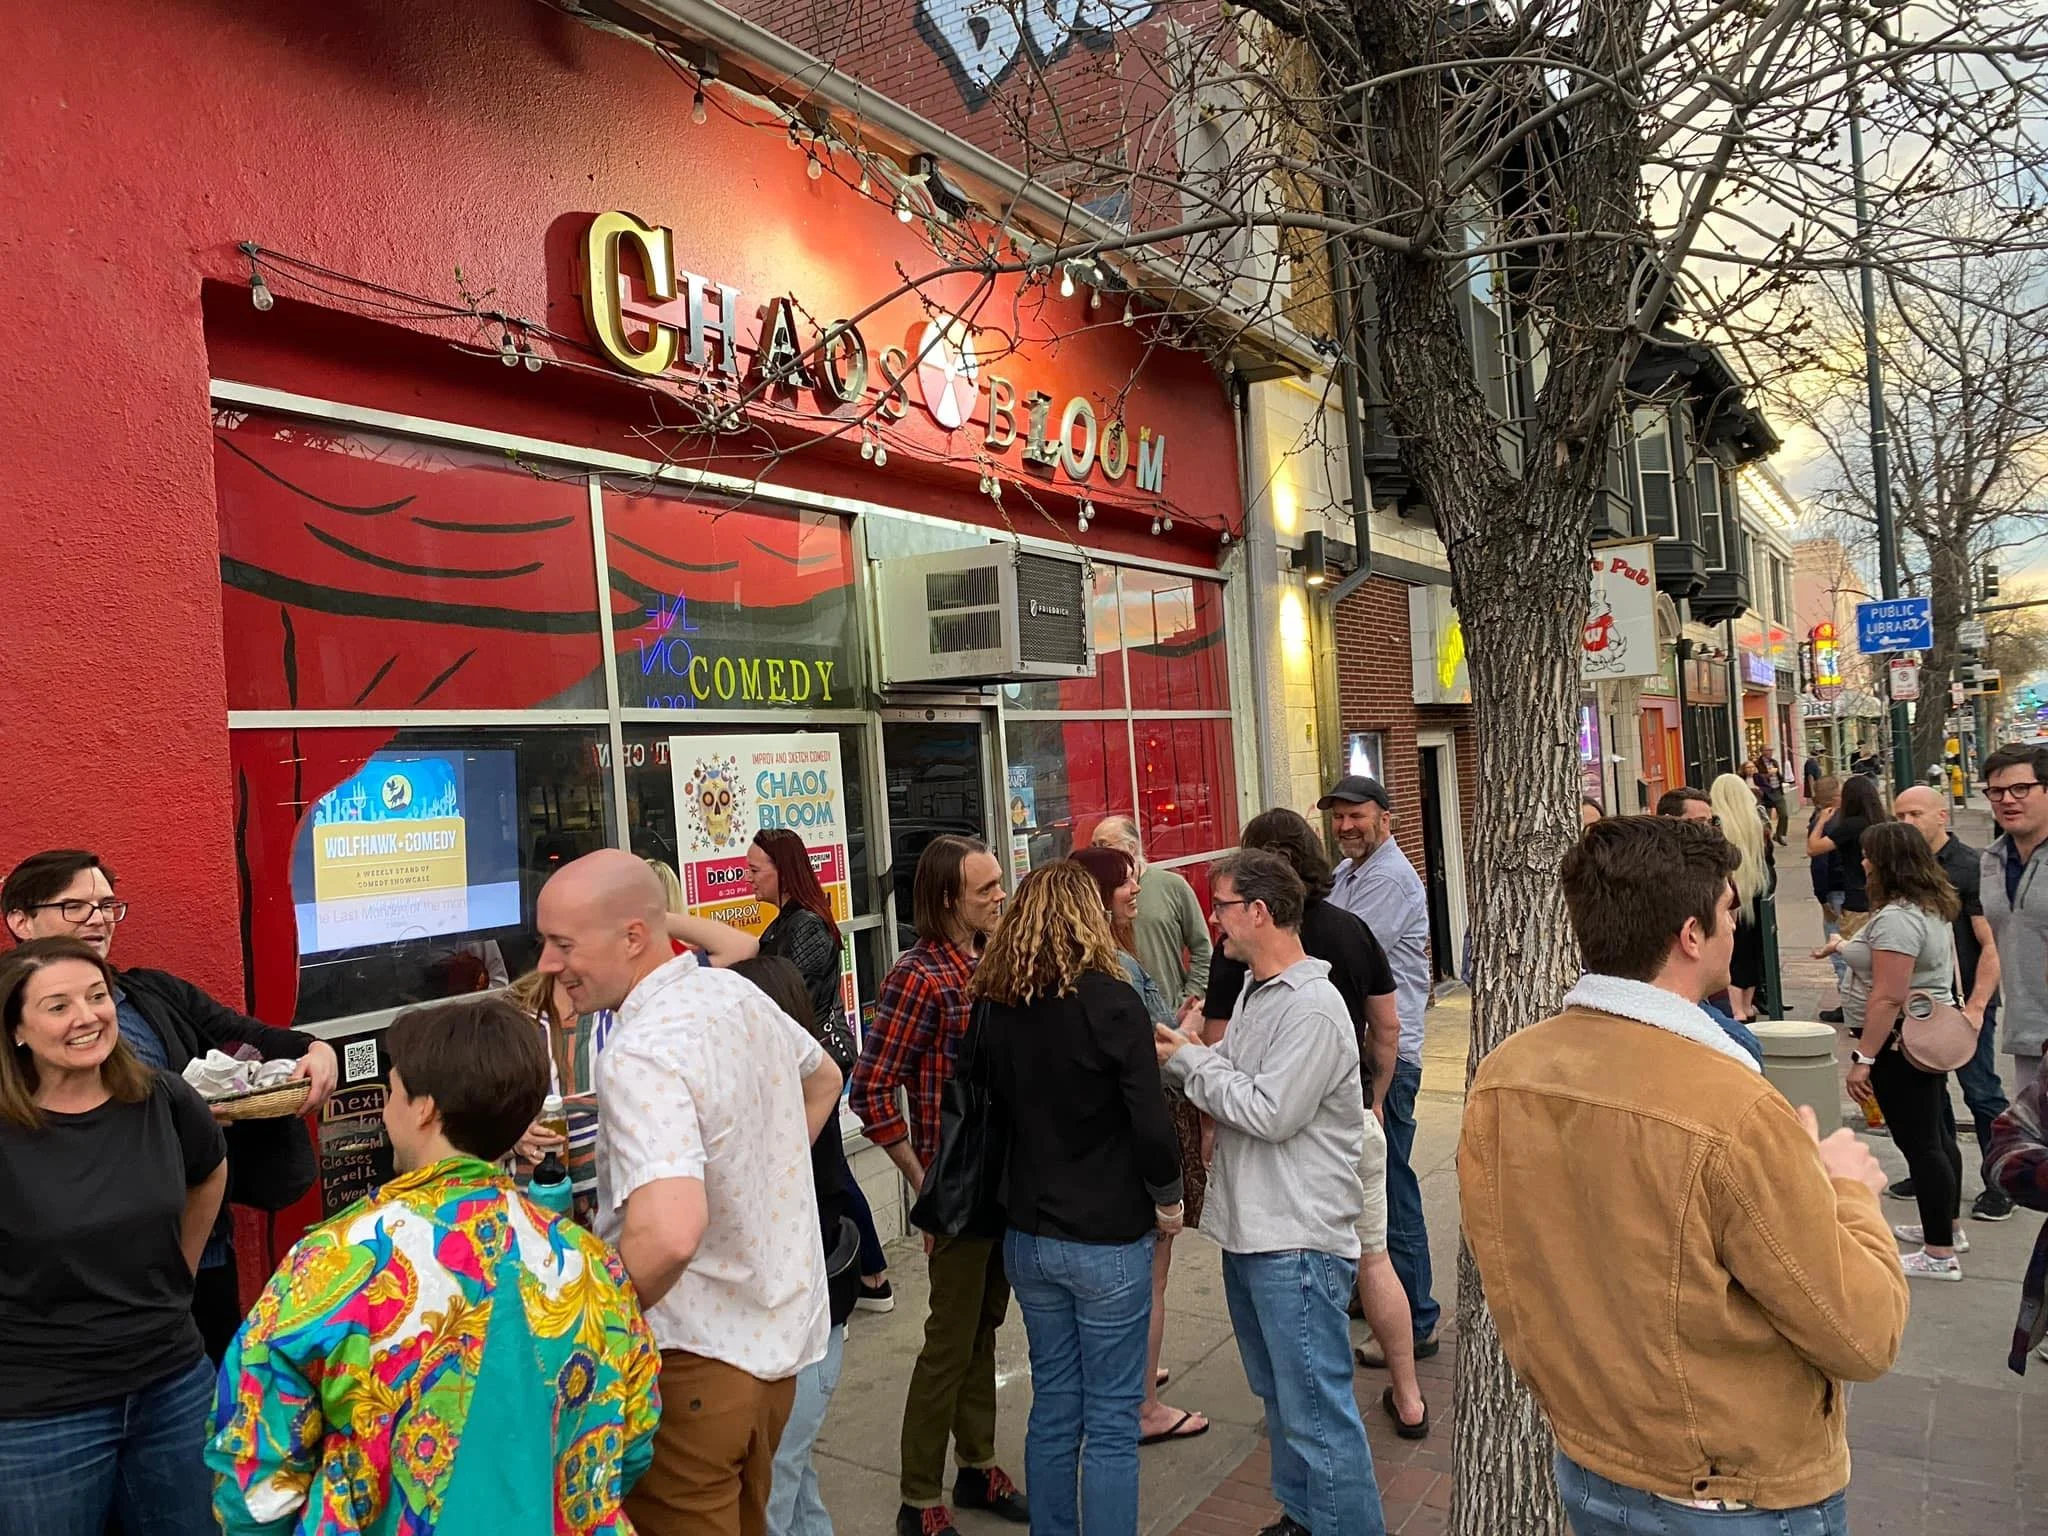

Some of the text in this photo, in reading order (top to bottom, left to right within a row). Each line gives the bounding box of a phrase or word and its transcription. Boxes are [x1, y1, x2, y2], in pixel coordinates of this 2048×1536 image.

[582, 211, 1164, 494] CHAOS BLOOM
[1610, 557, 1650, 586] Pub
[1871, 604, 1915, 619] PUBLIC
[1866, 618, 1920, 634] LIBRARY
[688, 655, 834, 701] COMEDY
[752, 750, 832, 765] IMPROV AND SKETCH COMEDY
[756, 769, 828, 799] CHAOS
[759, 800, 835, 829] BLOOM
[324, 830, 457, 859] WOLFHAWK COMEDY
[708, 868, 745, 885] DROP
[710, 903, 761, 921] IMPROV
[738, 915, 762, 928] TEAMS
[330, 1093, 382, 1118] next
[324, 1166, 361, 1189] Level
[327, 1190, 338, 1207] 6
